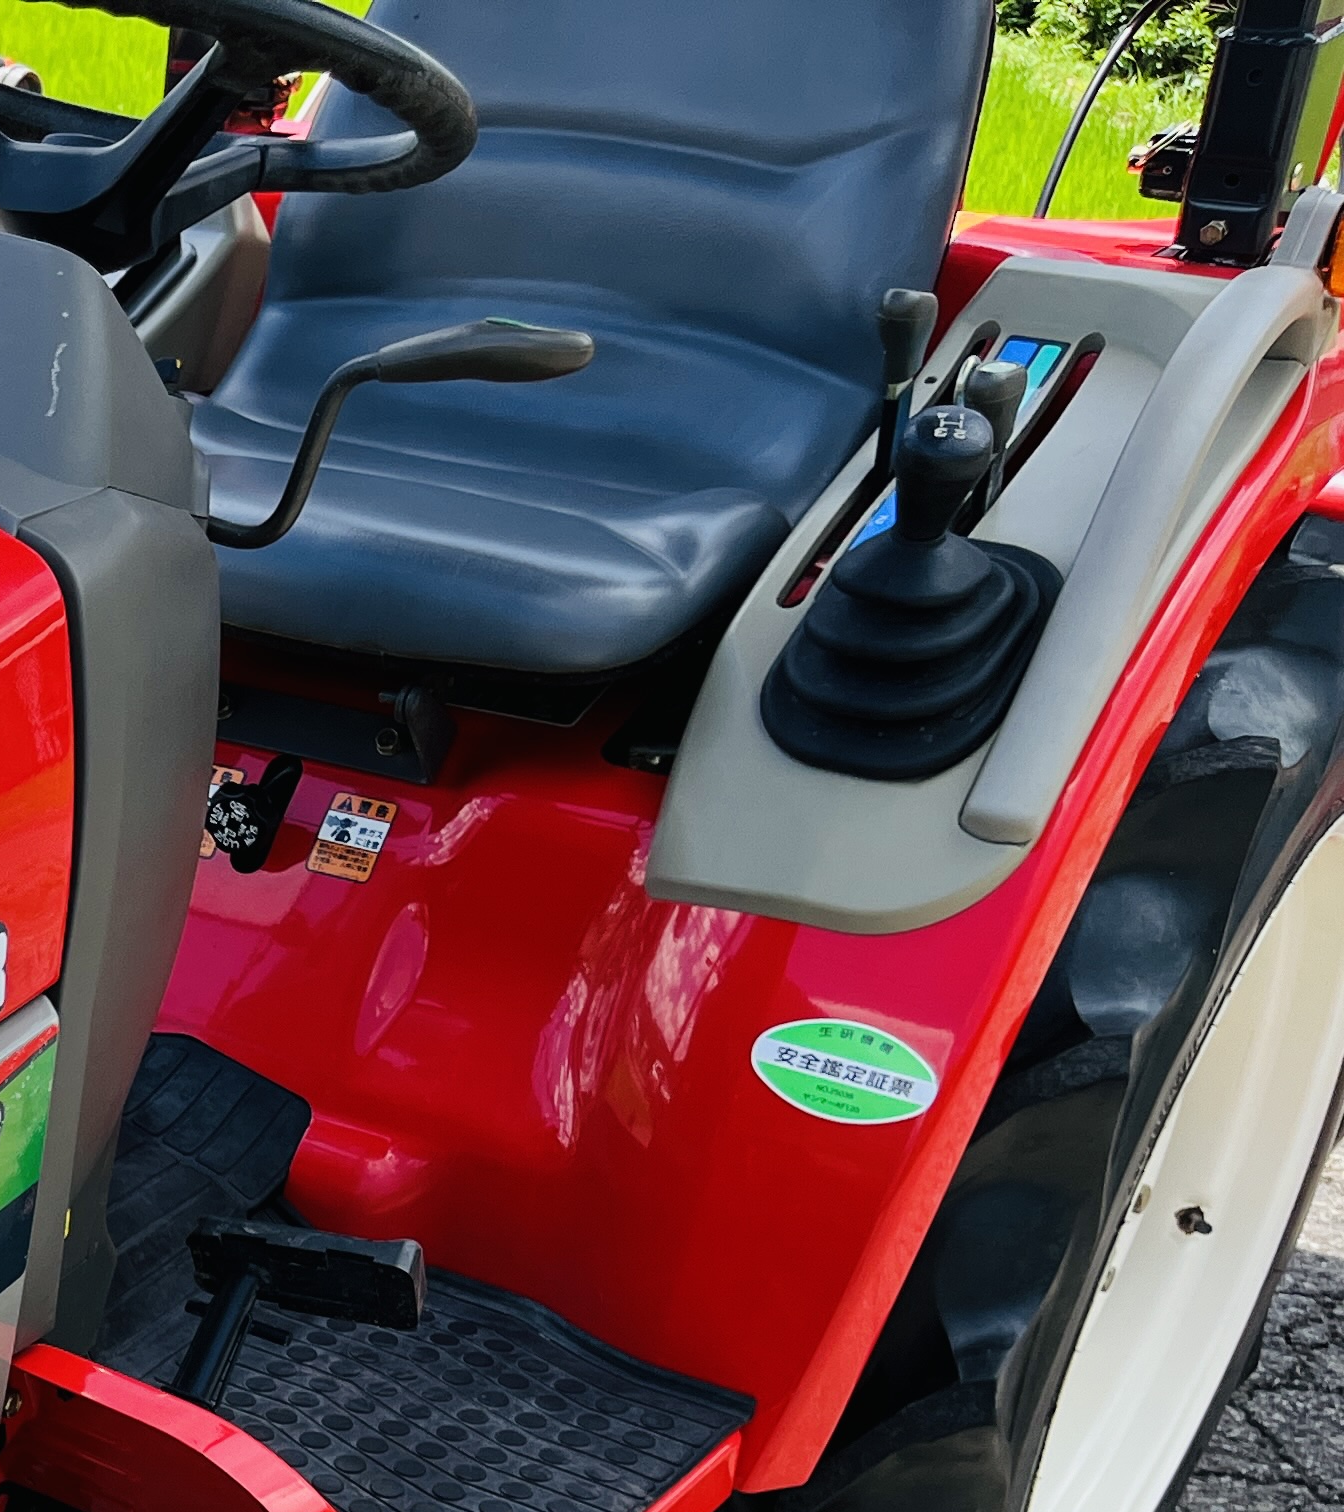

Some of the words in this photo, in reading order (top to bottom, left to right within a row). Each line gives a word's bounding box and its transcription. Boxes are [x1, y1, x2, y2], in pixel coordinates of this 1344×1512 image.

[774, 1046, 915, 1098] 安全鑑定証票
